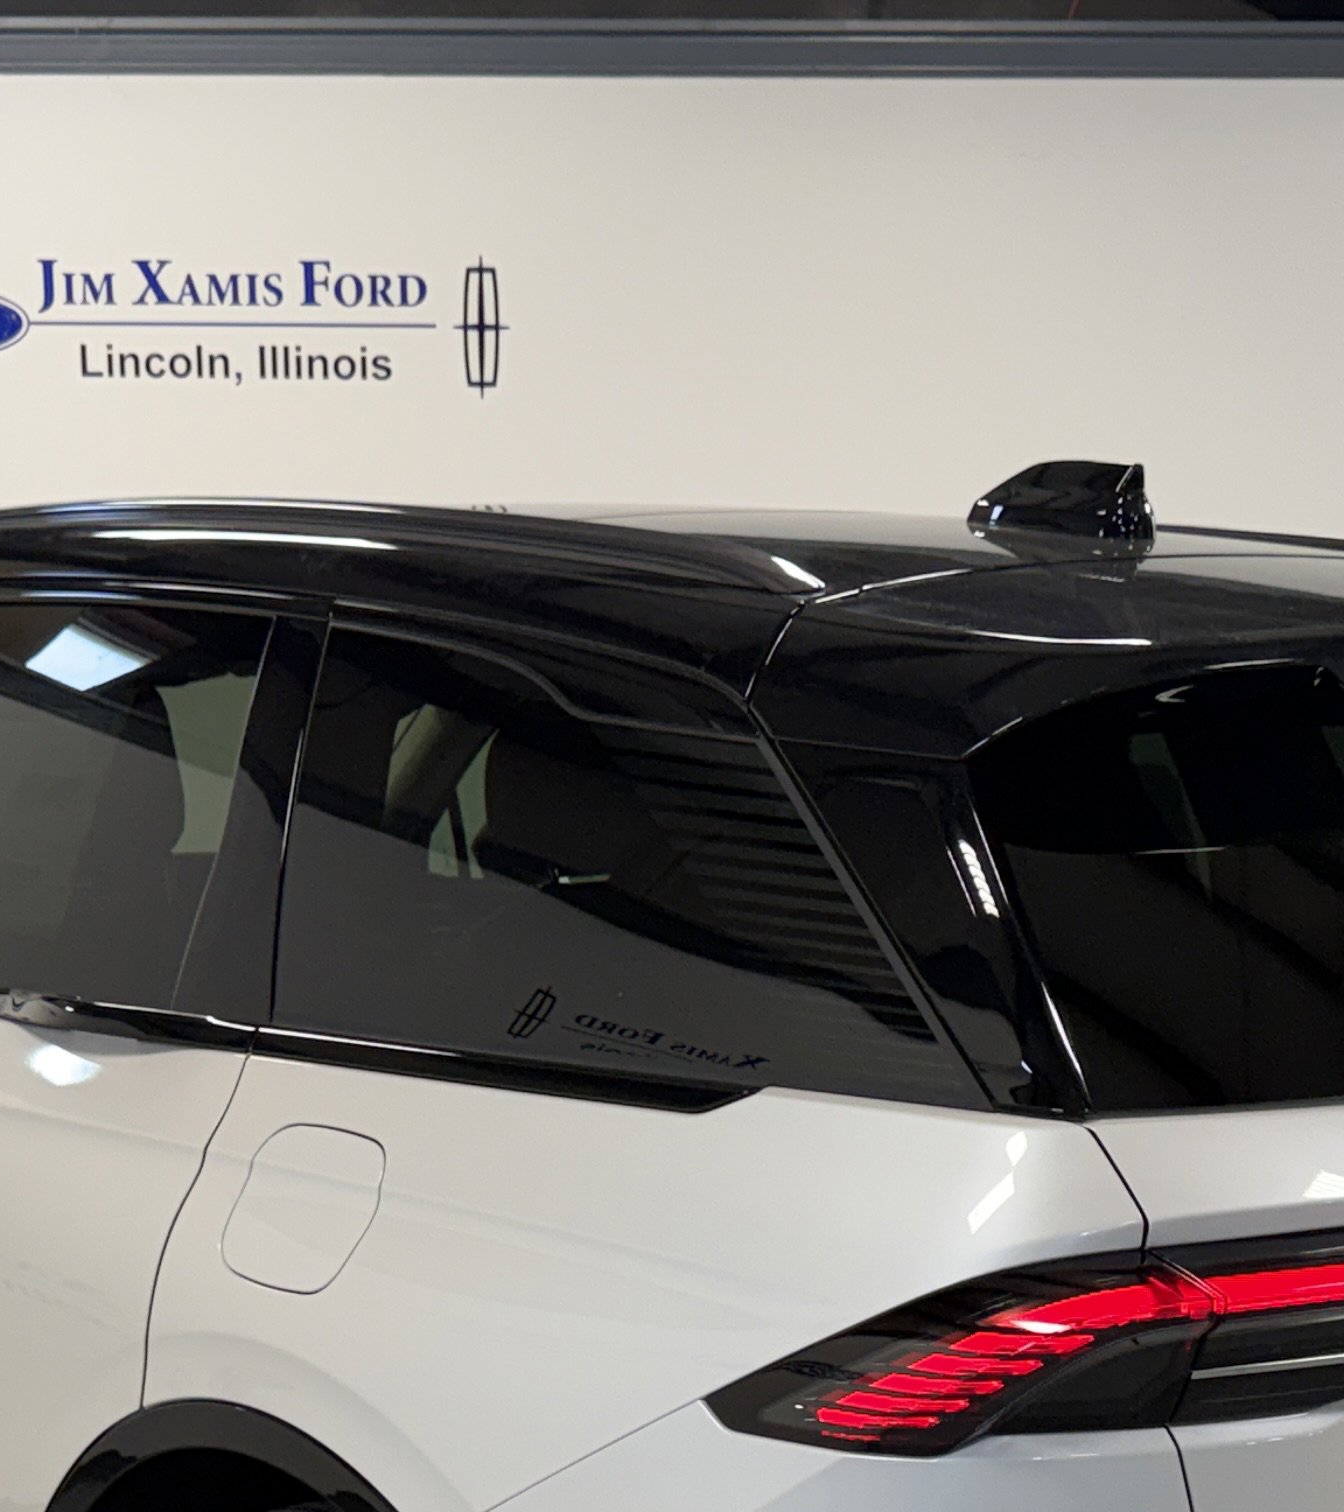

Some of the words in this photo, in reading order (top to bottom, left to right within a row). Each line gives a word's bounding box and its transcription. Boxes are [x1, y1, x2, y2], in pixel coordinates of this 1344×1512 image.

[36, 258, 115, 313] JIM
[131, 260, 283, 307] XAMIS
[299, 260, 428, 308] FORD
[79, 344, 243, 386] Lincoln,
[258, 346, 393, 381] Illinois
